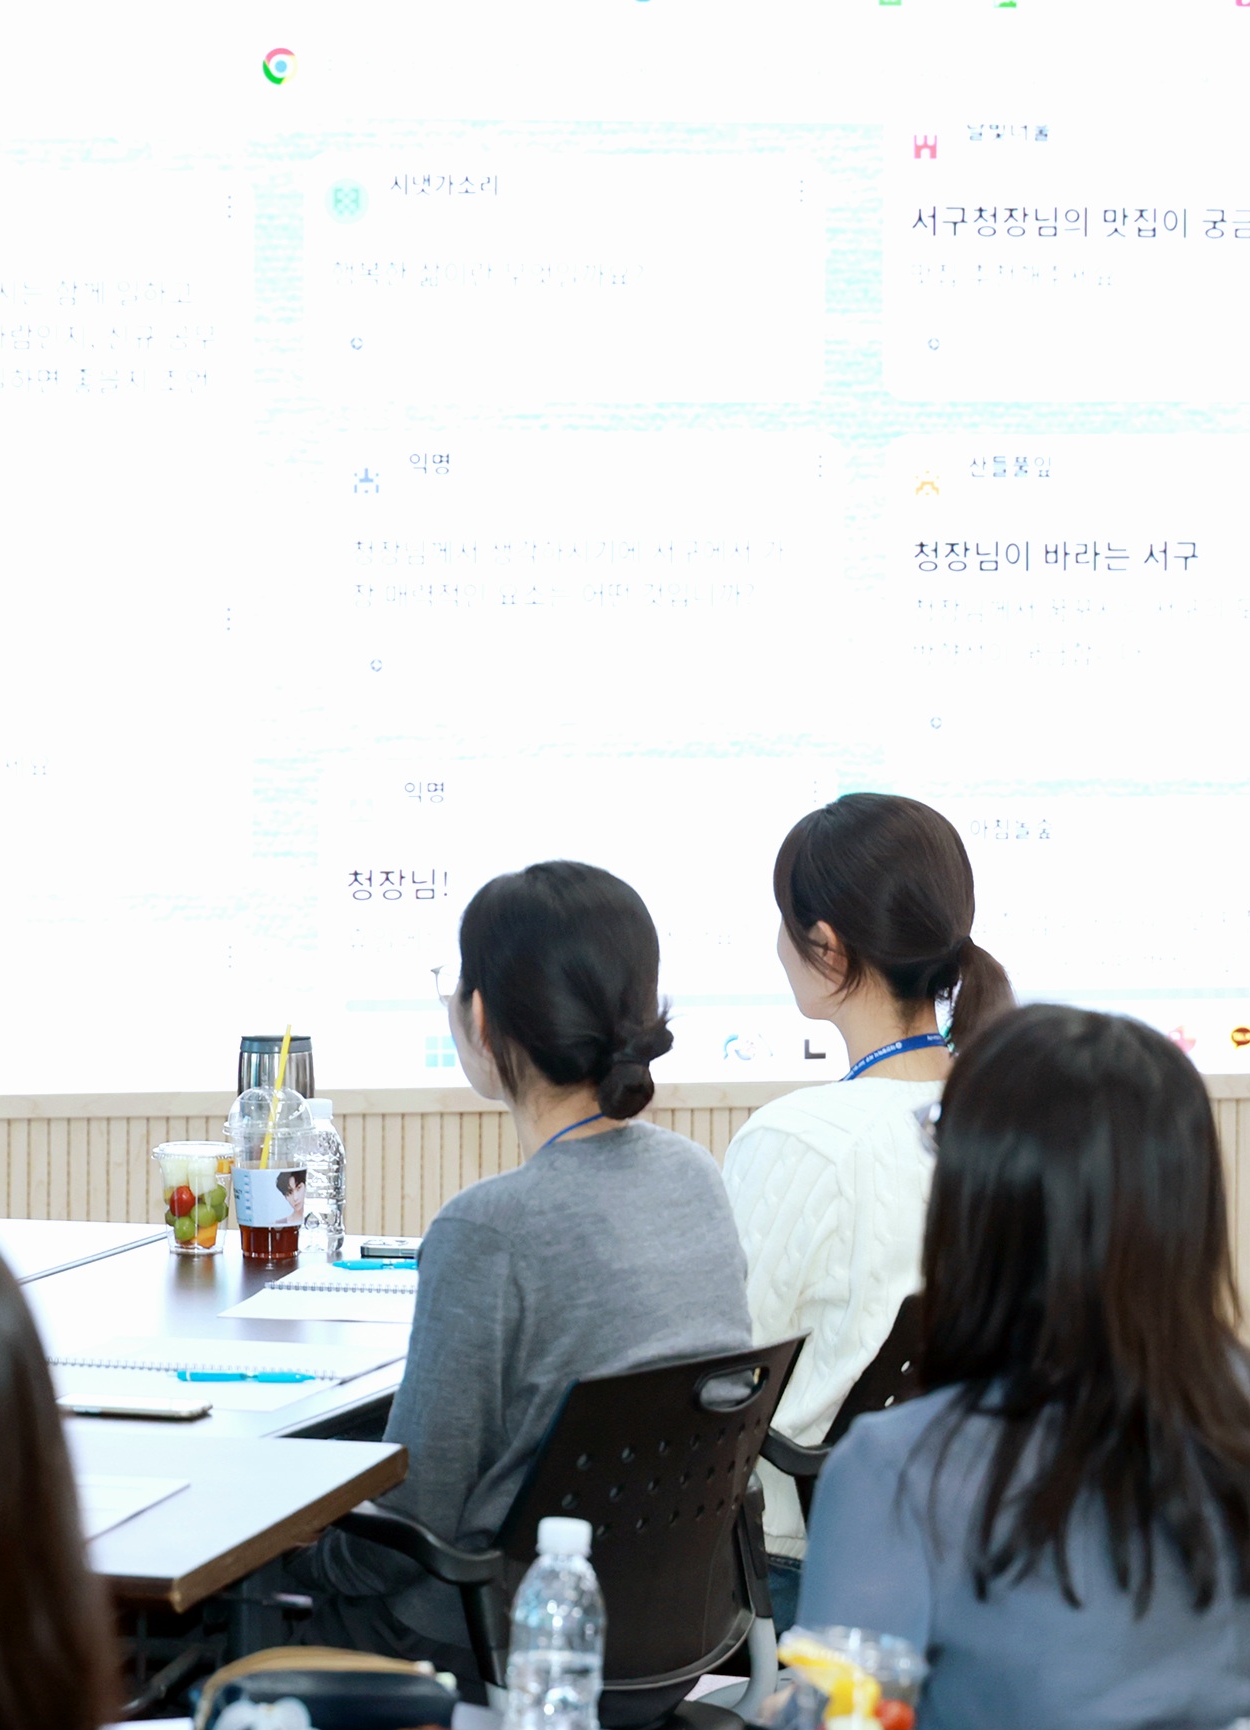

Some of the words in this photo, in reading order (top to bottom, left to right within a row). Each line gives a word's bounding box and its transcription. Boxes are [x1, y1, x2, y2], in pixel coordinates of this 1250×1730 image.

[390, 174, 499, 197] 시냇가소리
[912, 205, 1089, 239] 서구청장님의
[1102, 206, 1188, 240] 맛집이
[409, 453, 451, 476] 익명
[913, 540, 1031, 573] 청장님이
[1043, 540, 1131, 573] 바라는
[1143, 540, 1199, 573] 서구
[404, 781, 446, 804] 익명
[347, 867, 449, 902] 청장님!
